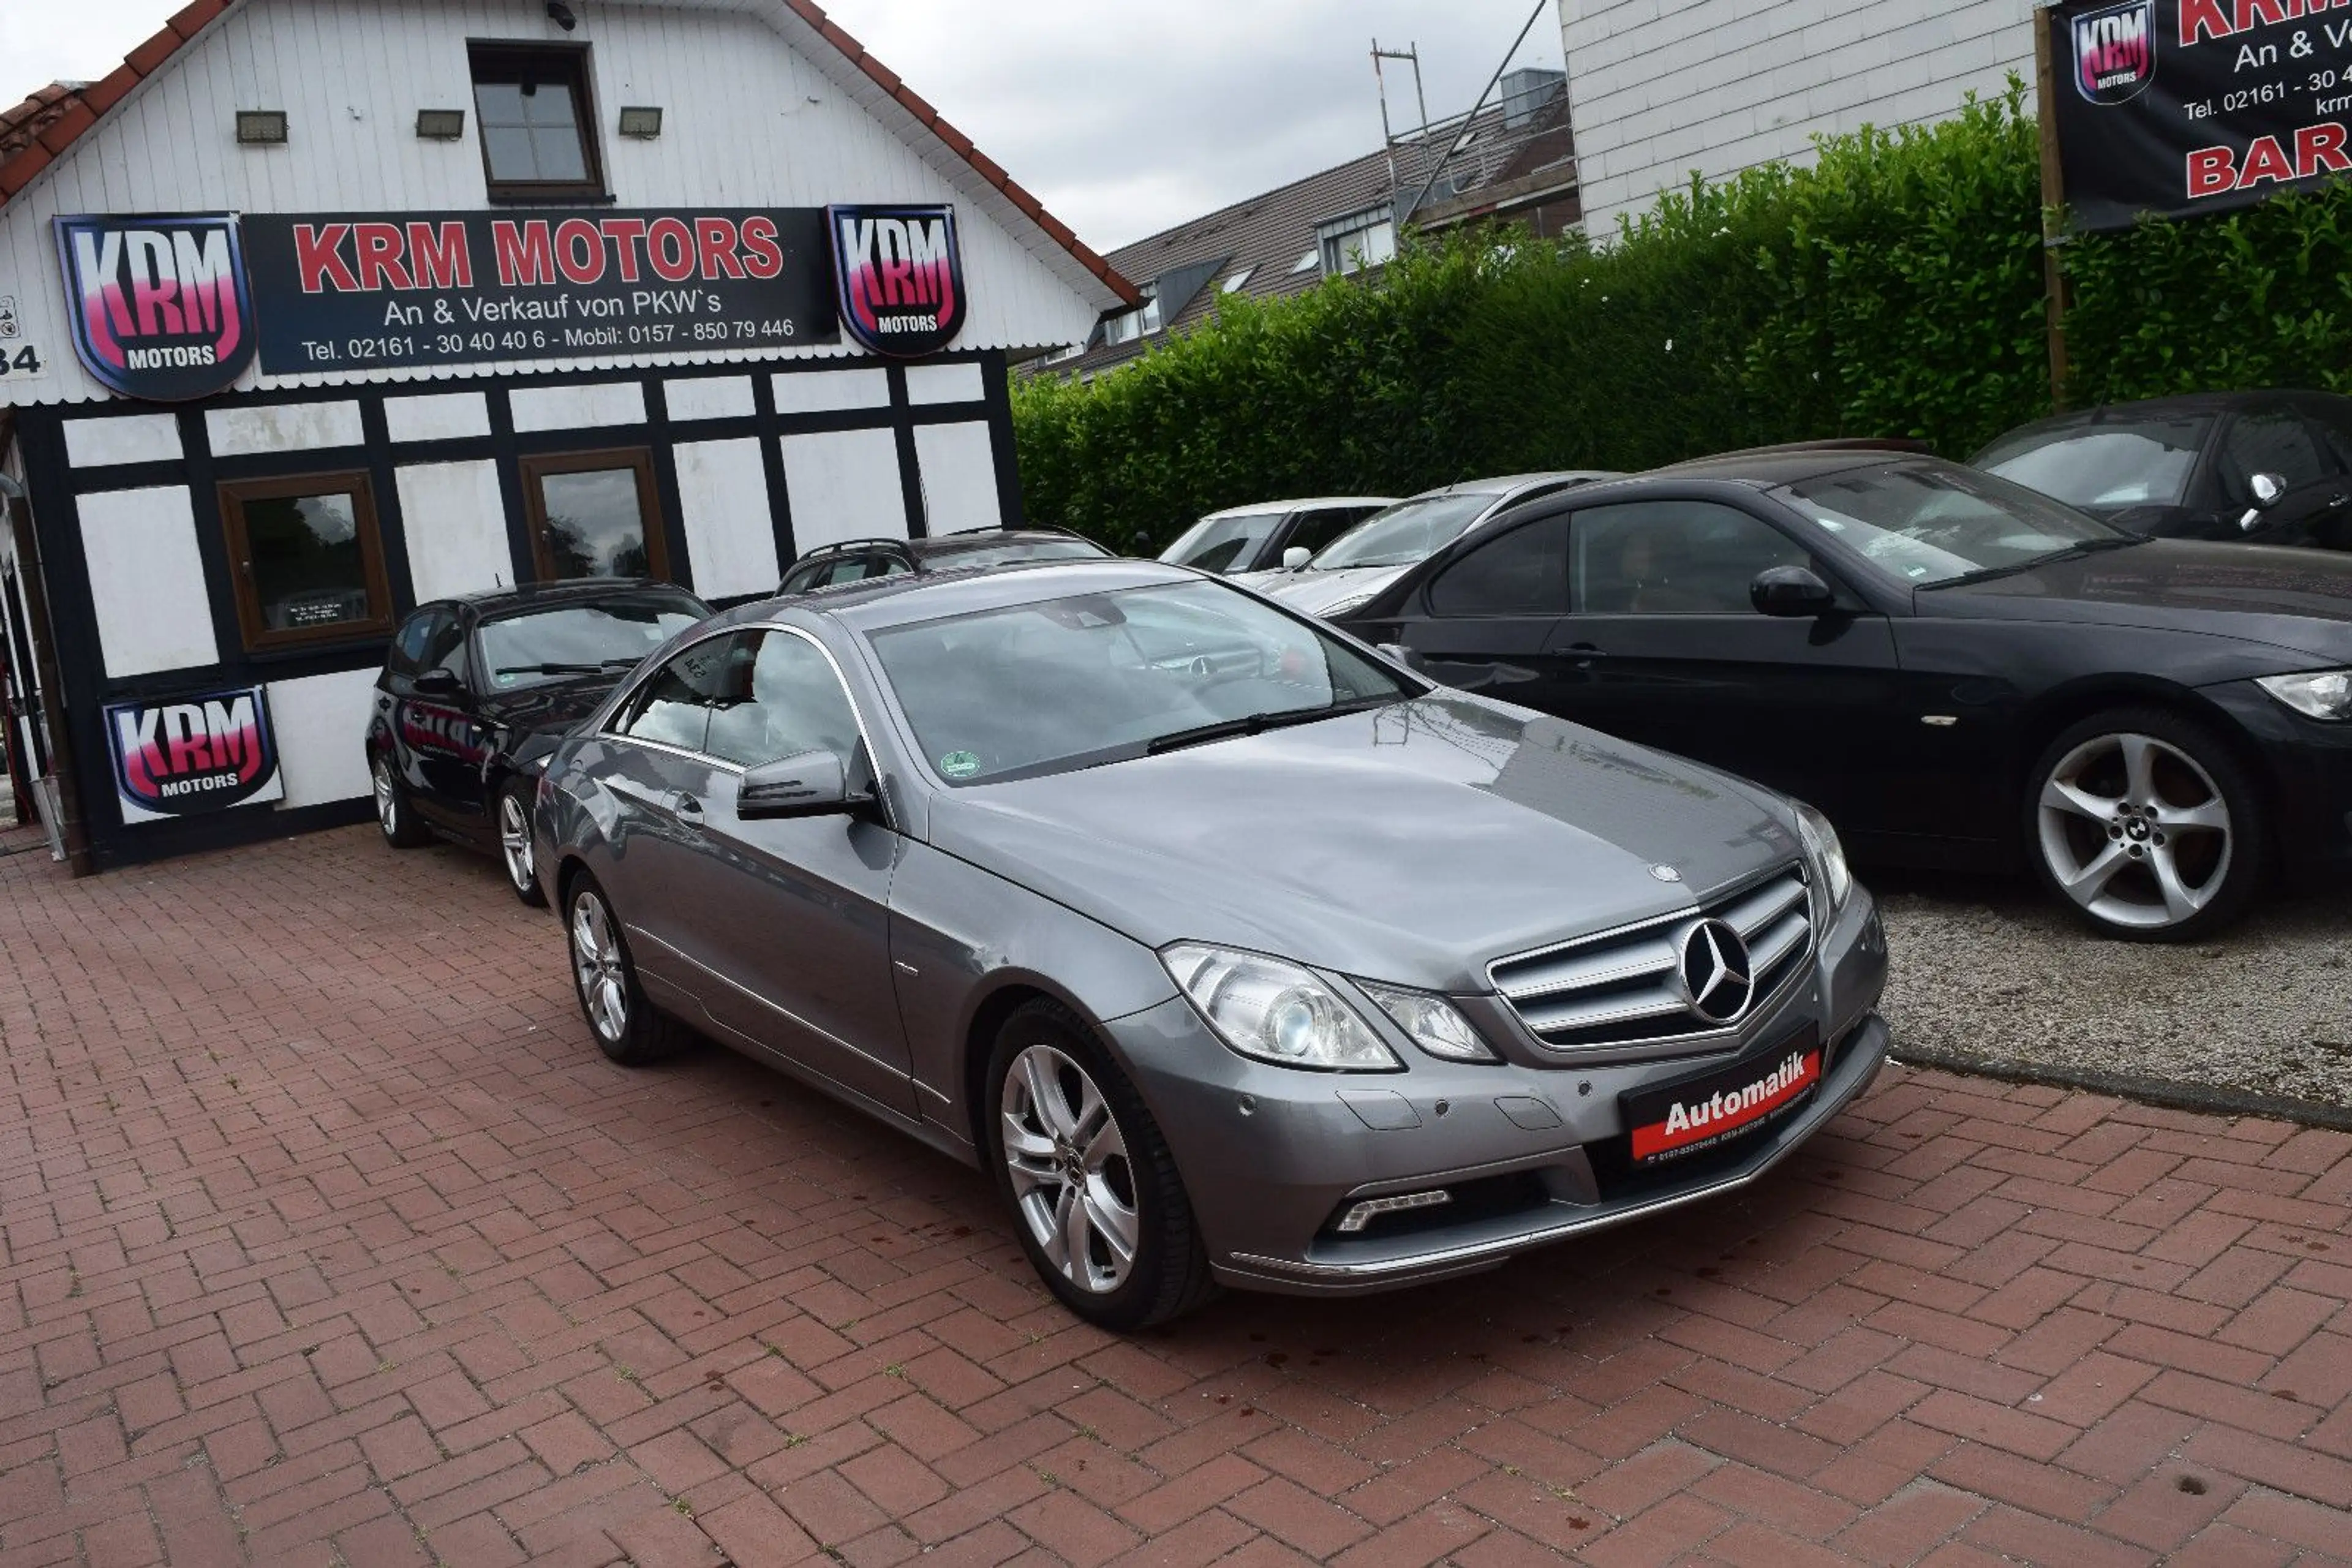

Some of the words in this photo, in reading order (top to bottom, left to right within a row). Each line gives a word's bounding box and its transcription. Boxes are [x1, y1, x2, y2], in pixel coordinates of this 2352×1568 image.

[2079, 9, 2148, 89] KRM
[2234, 44, 2277, 72] An
[2290, 31, 2313, 58] &
[2324, 19, 2352, 48] V
[2098, 71, 2136, 90] MOTORS
[2184, 99, 2217, 119] Tel.
[2224, 81, 2284, 111] 02161
[2308, 70, 2335, 91] 30
[2186, 122, 2352, 199] BAR
[293, 221, 473, 293] KRM
[491, 216, 783, 287] MOTORS
[842, 219, 954, 331] KRM
[73, 229, 241, 369] KRM
[384, 301, 423, 326] An
[434, 298, 455, 323] &
[461, 294, 568, 322] Verkauf
[576, 297, 624, 317] von
[877, 314, 938, 333] MOTORS
[127, 344, 216, 370] MOTORS
[302, 341, 342, 361] Tel.
[348, 336, 414, 358] 02161
[437, 334, 462, 353] 30
[469, 332, 494, 352] 40
[502, 331, 526, 350] 40
[533, 330, 545, 349] 6
[565, 327, 623, 347] Mobil:
[628, 325, 674, 344] 0157
[693, 322, 728, 341] 850
[733, 320, 755, 339] 79
[761, 318, 794, 336] 446
[118, 696, 263, 798] KRM
[161, 772, 239, 797] MOTORS
[1665, 1051, 1805, 1135] Automatik
